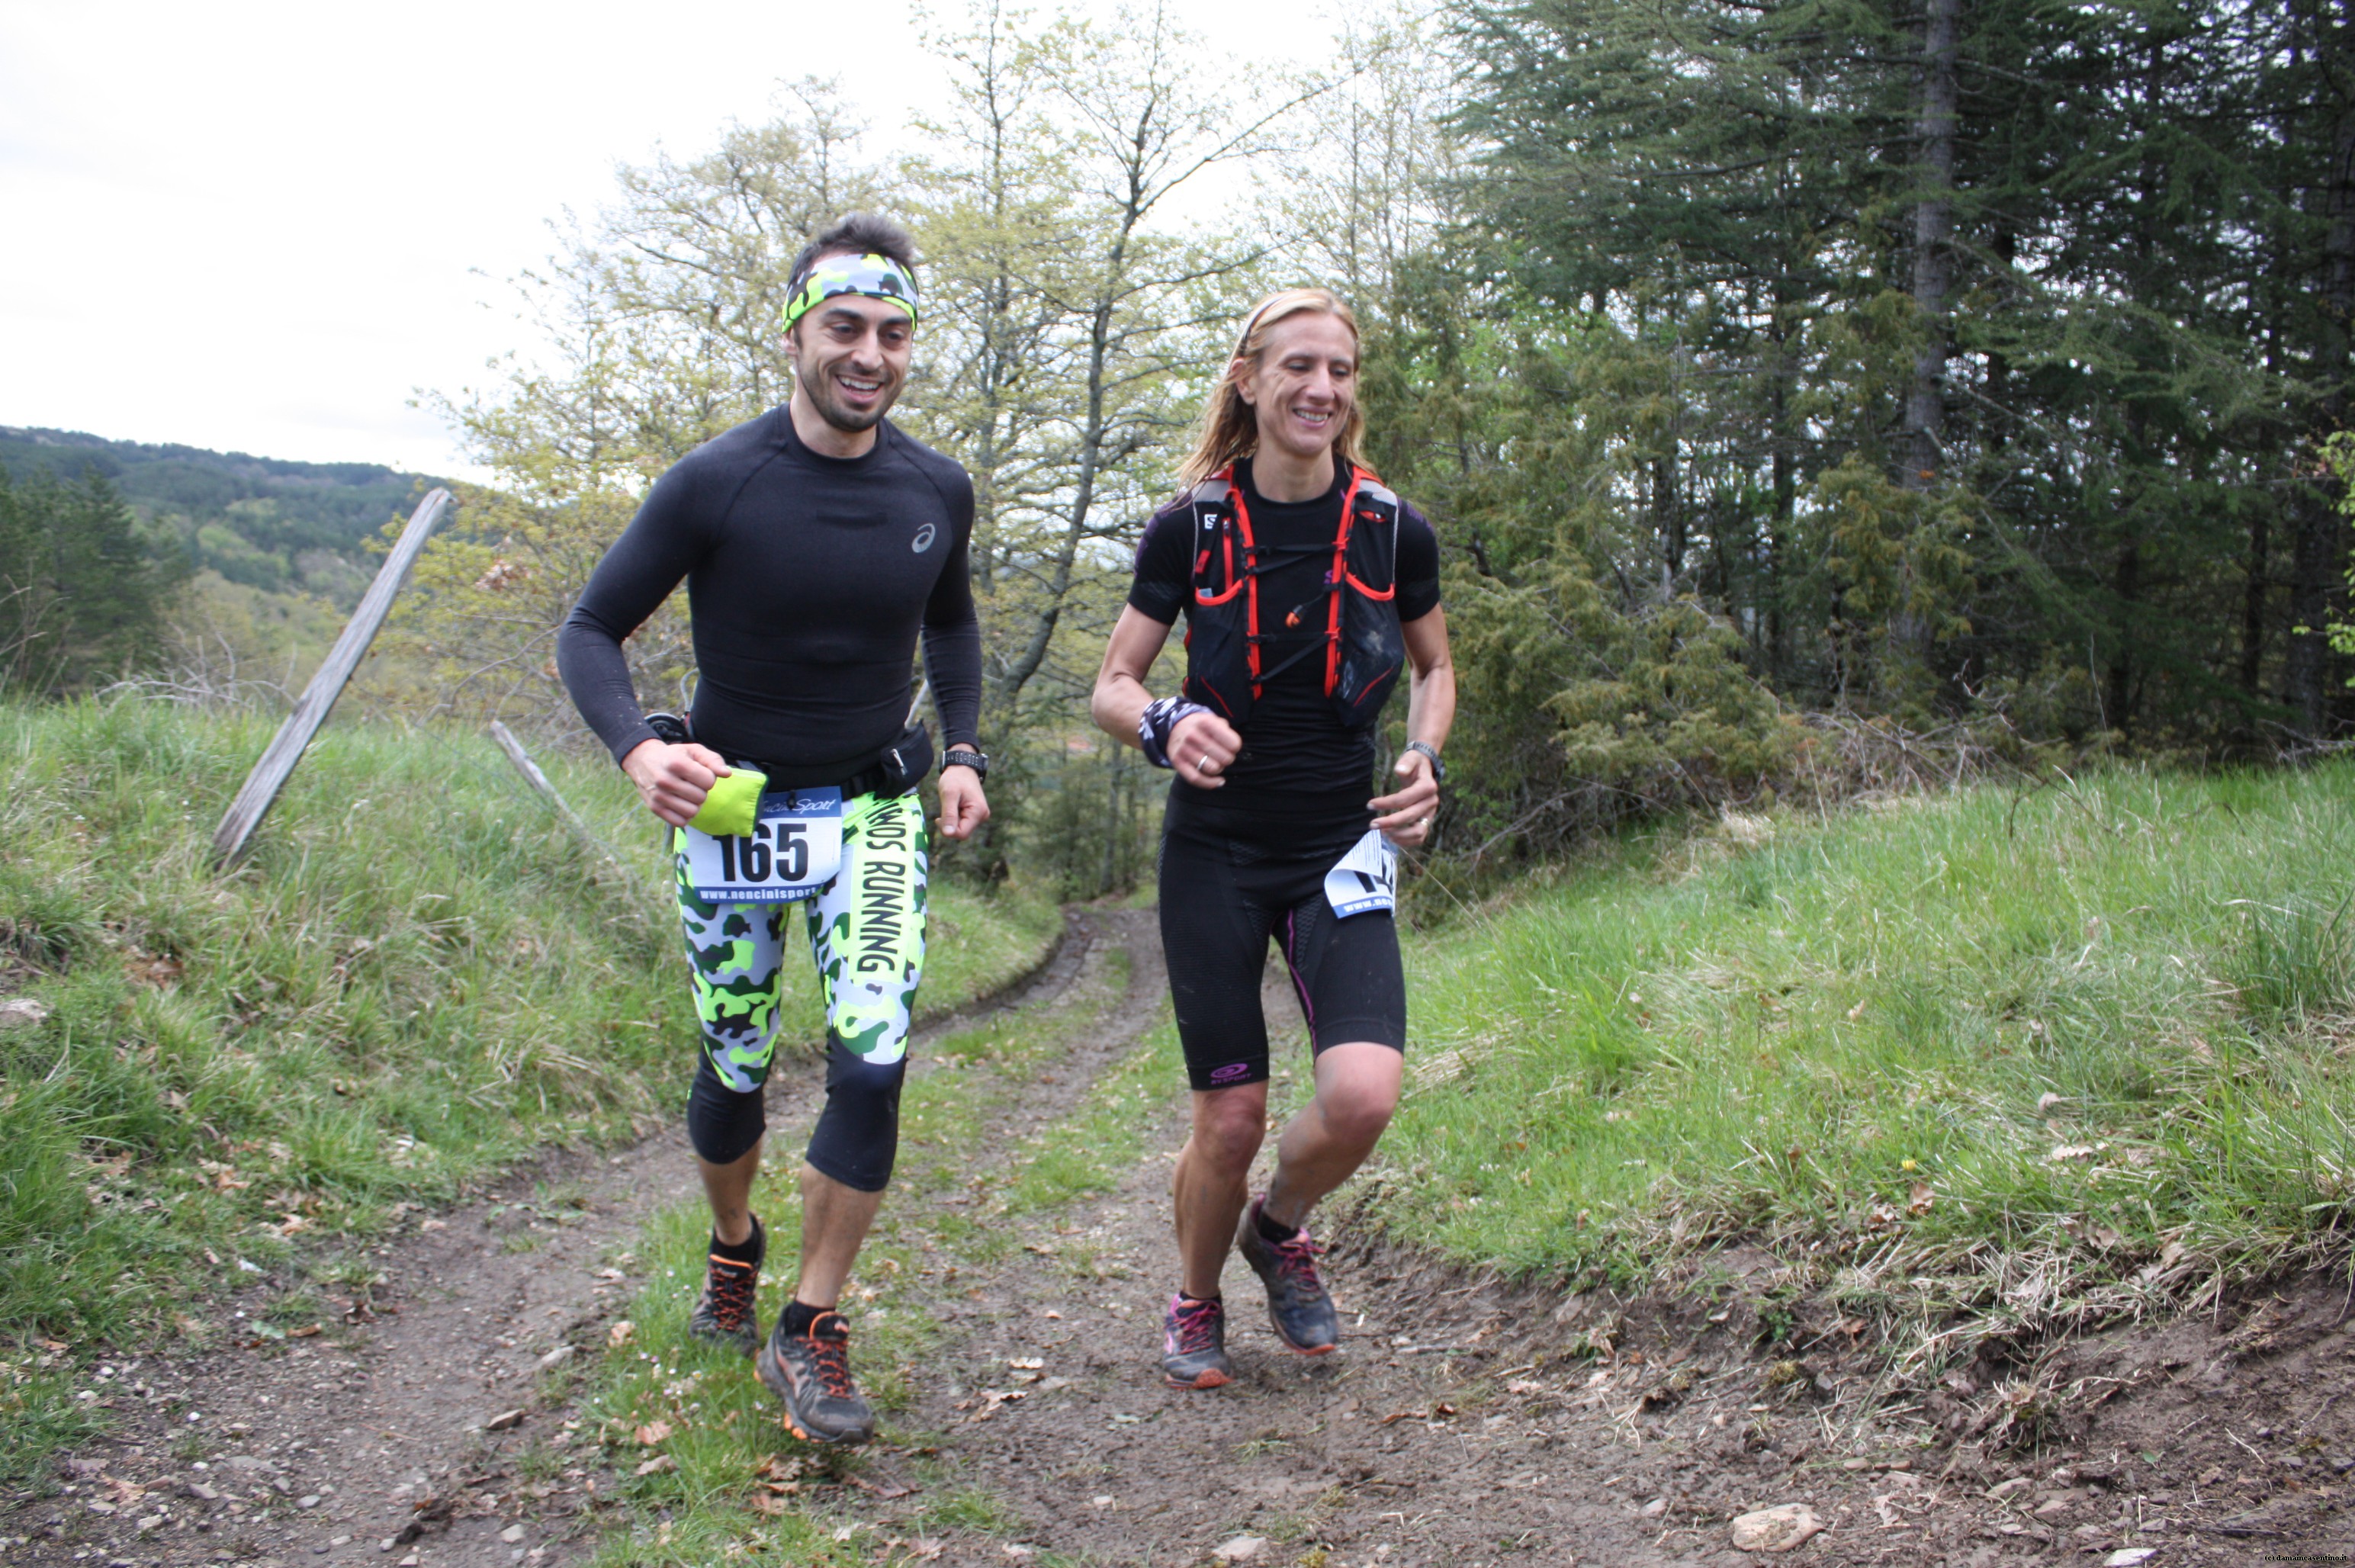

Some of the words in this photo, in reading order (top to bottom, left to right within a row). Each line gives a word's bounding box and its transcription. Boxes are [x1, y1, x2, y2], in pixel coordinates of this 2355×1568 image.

[792, 798, 837, 815] Sport
[712, 823, 808, 882] 165
[856, 860, 906, 972] RUNNING
